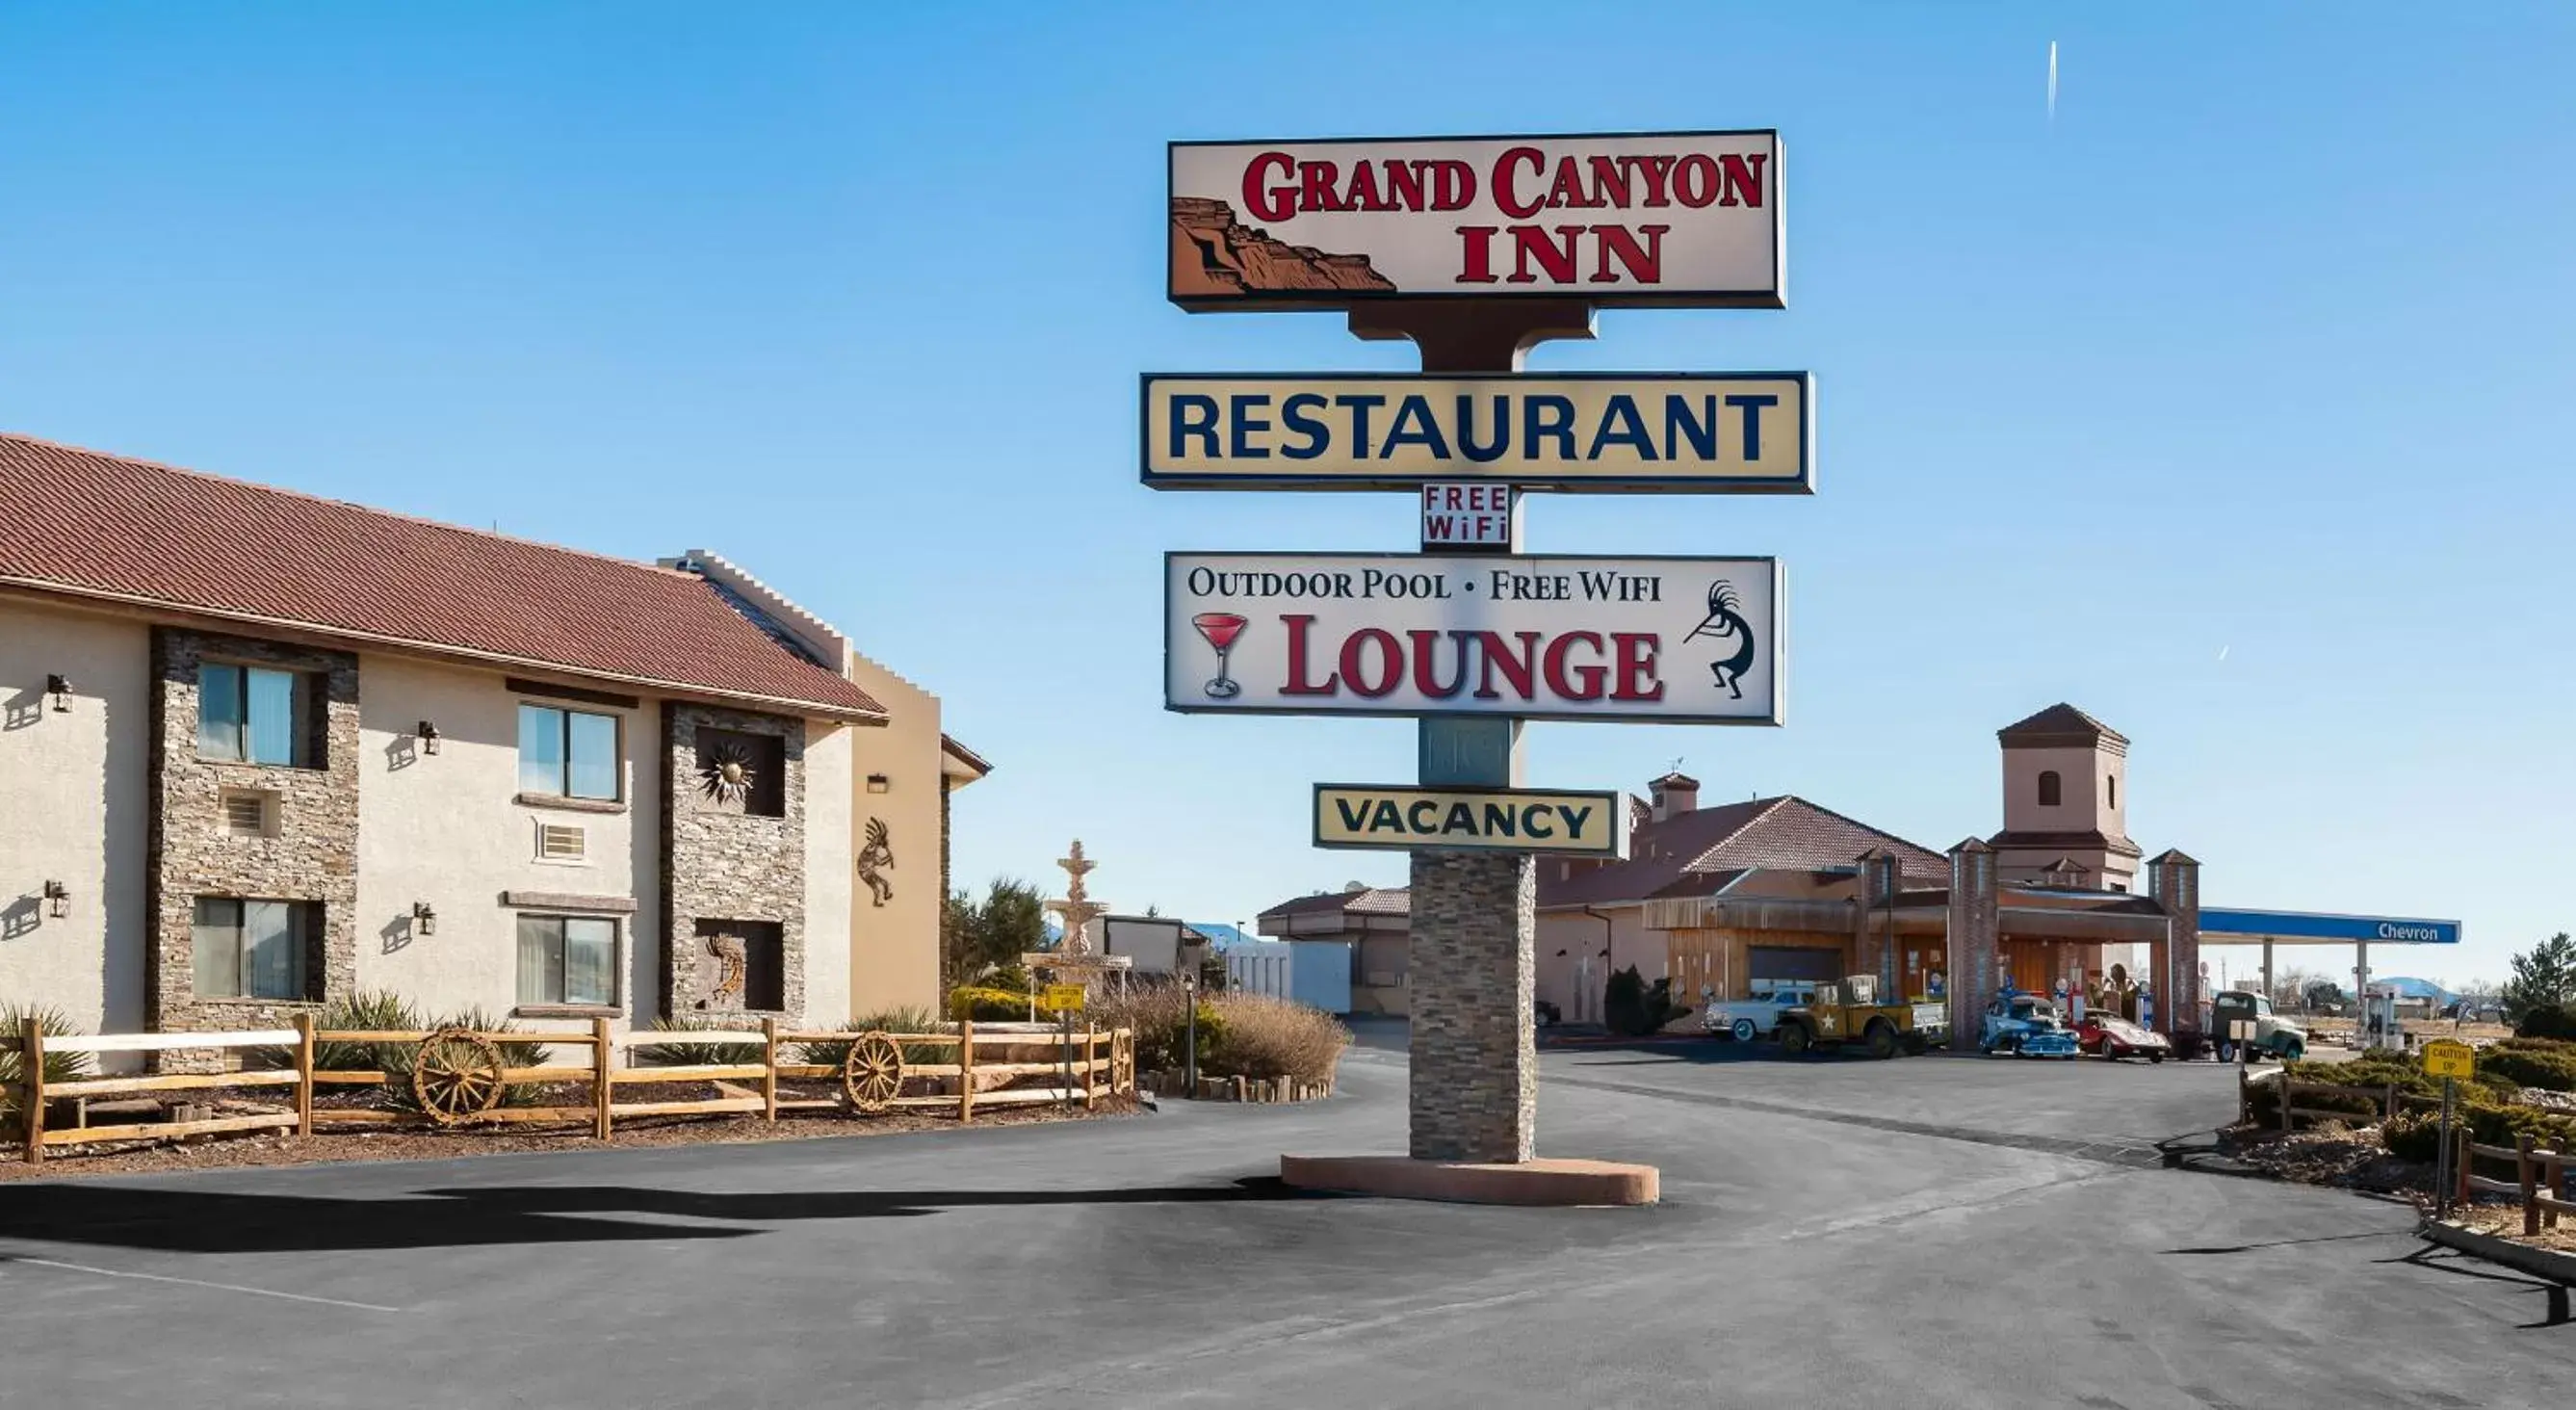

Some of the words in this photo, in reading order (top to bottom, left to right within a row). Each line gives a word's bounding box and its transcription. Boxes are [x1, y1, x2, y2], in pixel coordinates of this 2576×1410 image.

[1242, 151, 1477, 222] GRAND
[1492, 146, 1768, 220] CANYON
[1455, 224, 1671, 284] INN
[1168, 393, 1780, 461] RESTAURANT
[1425, 486, 1507, 511] FREE
[1425, 515, 1507, 540] WiFi
[1187, 566, 1353, 599] OUTDOOR
[1362, 568, 1452, 600] POOL
[1490, 570, 1572, 602] FREE
[1278, 614, 1664, 702] LOUNGE
[1335, 797, 1593, 840] VACANCY
[2378, 923, 2437, 940] Chevron
